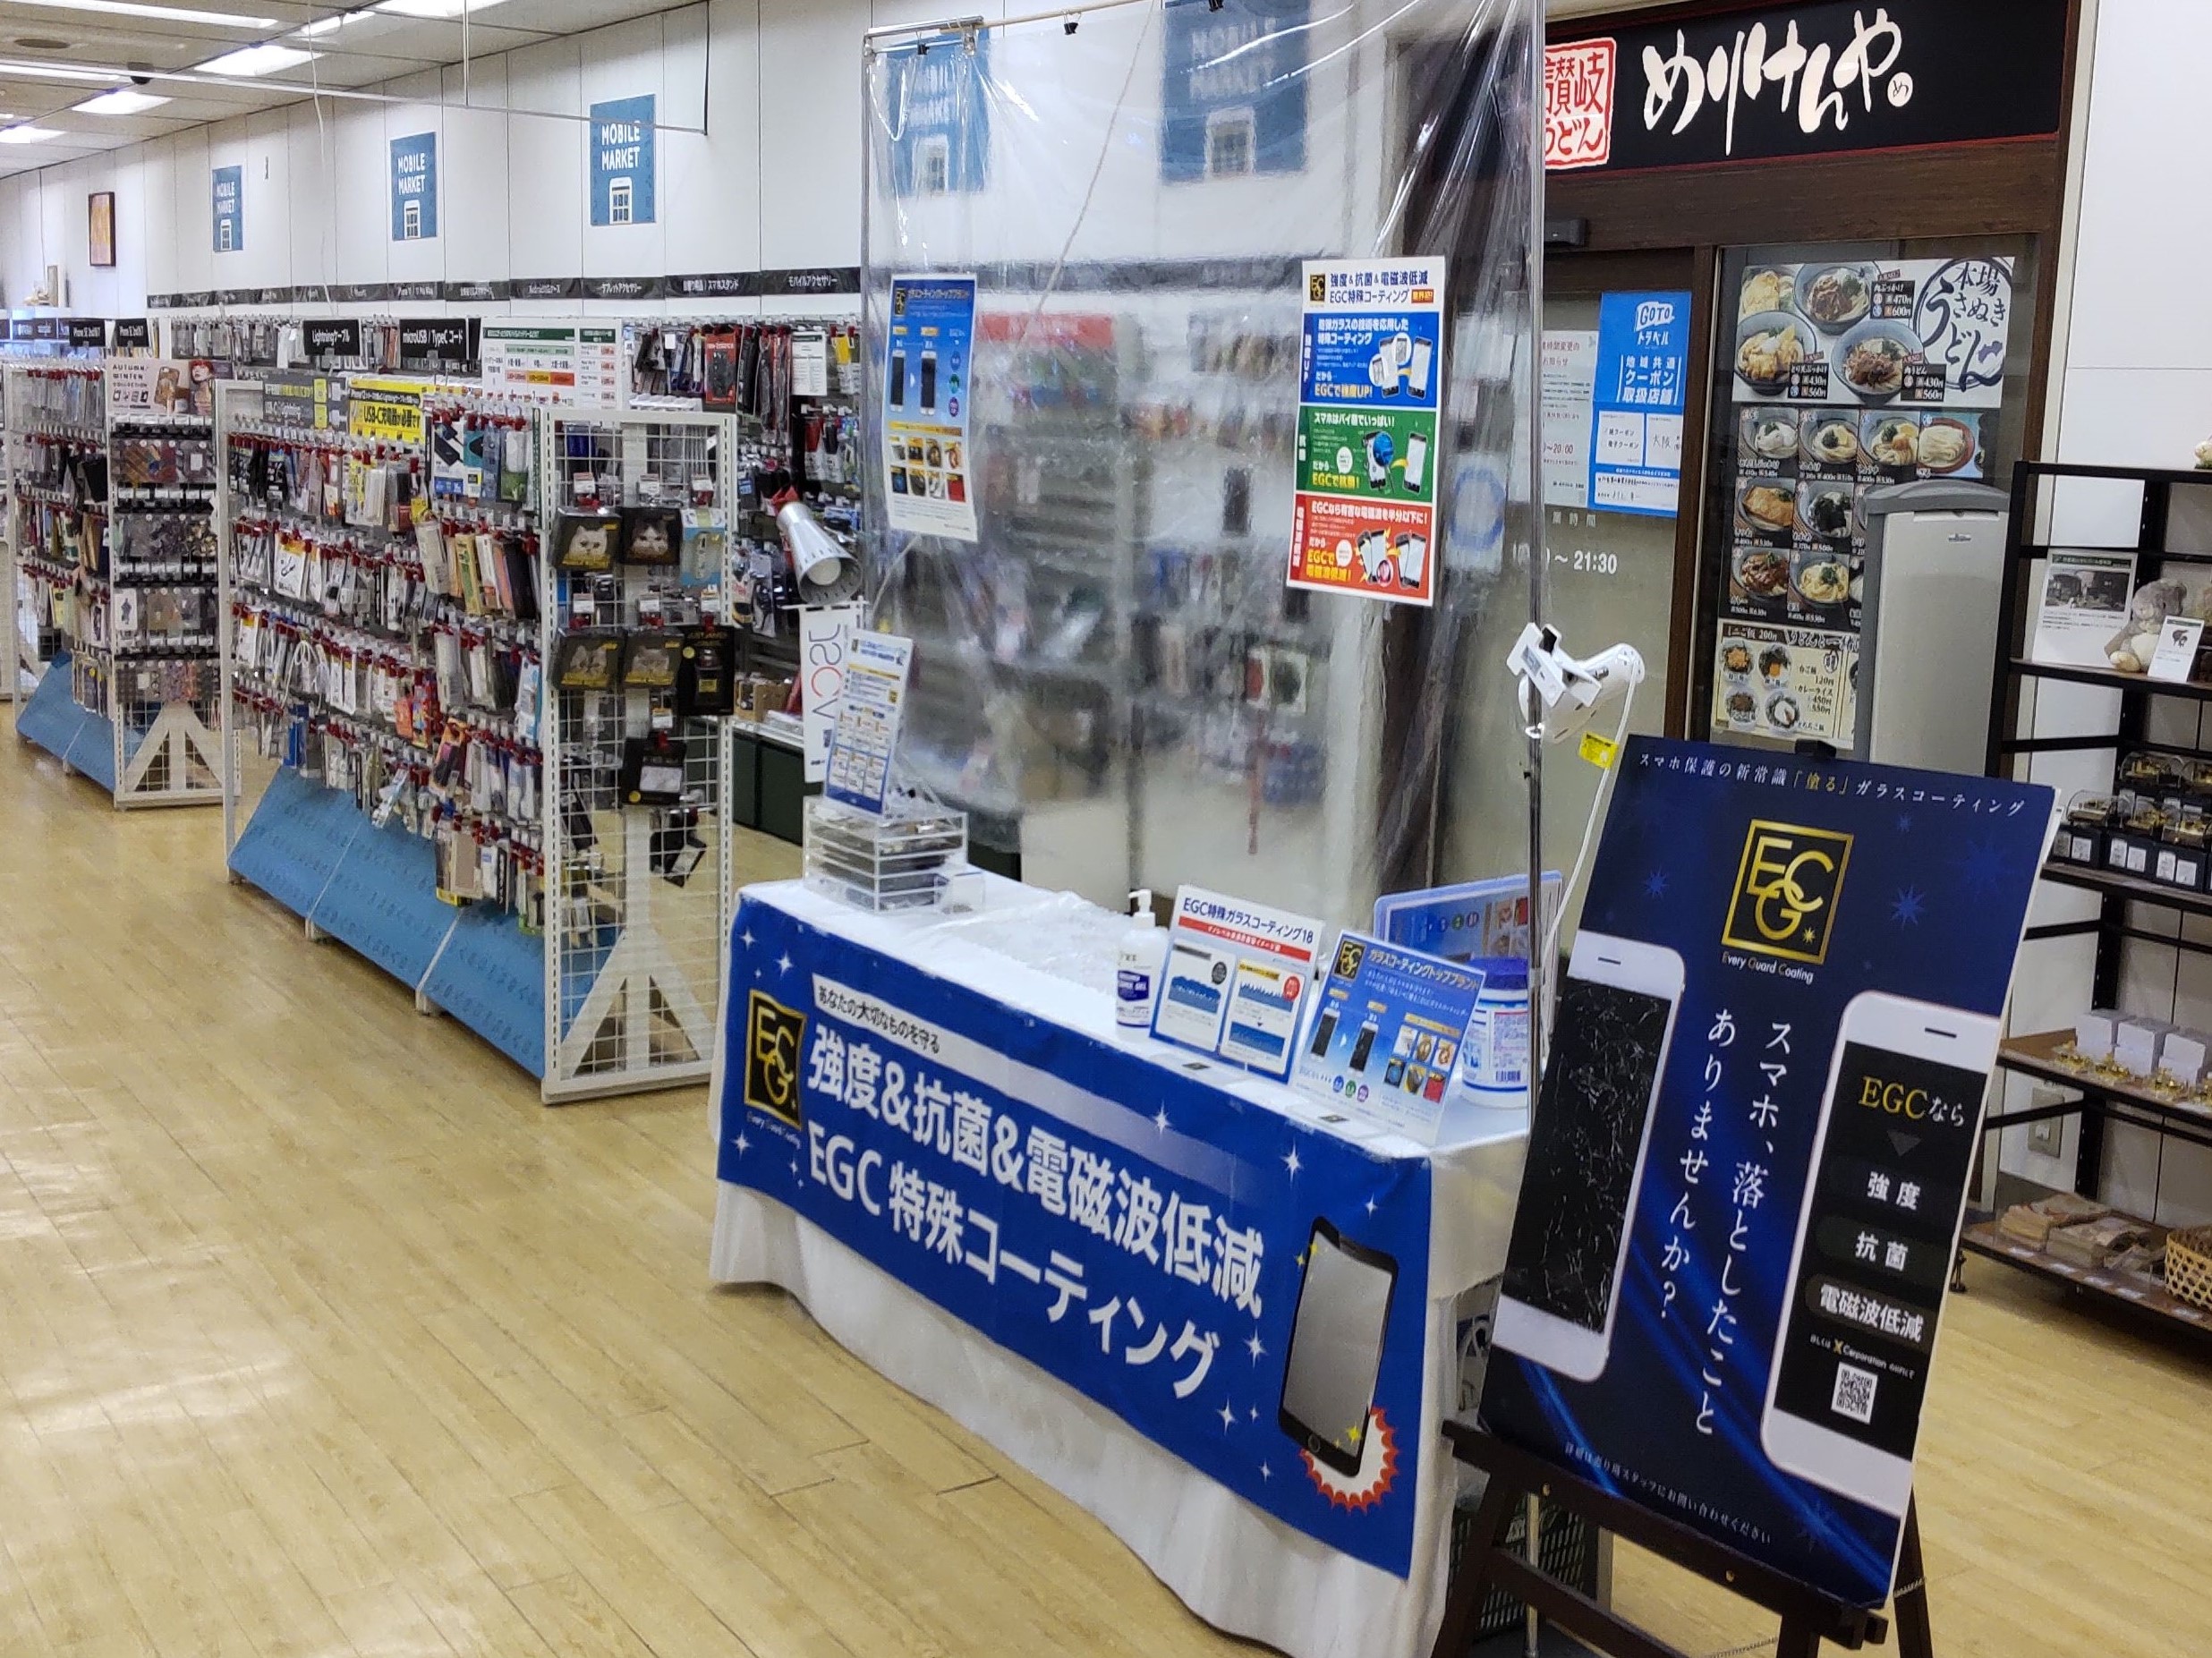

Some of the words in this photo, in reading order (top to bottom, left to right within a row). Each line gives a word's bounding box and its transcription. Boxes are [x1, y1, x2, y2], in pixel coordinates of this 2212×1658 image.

[601, 120, 641, 146] MOBILE
[397, 153, 425, 174] MOBILE
[601, 146, 641, 171] MARKET
[398, 174, 426, 195] MARKET
[1954, 262, 2001, 296] 本場
[1953, 293, 2006, 327] さぬき
[403, 329, 428, 345] microUSB
[1638, 331, 1669, 345] トラベル
[1919, 276, 2003, 392] うどん
[1626, 370, 1674, 387] クーポン
[1622, 387, 1673, 405] 取扱店舗
[1573, 550, 1618, 574] 21:30
[1183, 897, 1314, 944] EGC特殊ガラスコーティング18
[1722, 951, 1747, 971] Every
[1748, 957, 1777, 974] Guard
[1778, 964, 1814, 984] Coating
[818, 986, 940, 1054] あなたの大切なものを守る
[1858, 1076, 1965, 1127] EGCなら
[807, 1023, 1265, 1318] 強度&抗菌&電磁波低減
[1661, 1008, 1736, 1319] ありませんか?
[1867, 1171, 1921, 1211] 強度
[807, 1120, 882, 1217] EGC
[889, 1161, 1222, 1400] 特殊コーティング
[1855, 1230, 1909, 1272] 抗菌
[1819, 1283, 1925, 1342] 電磁波低減
